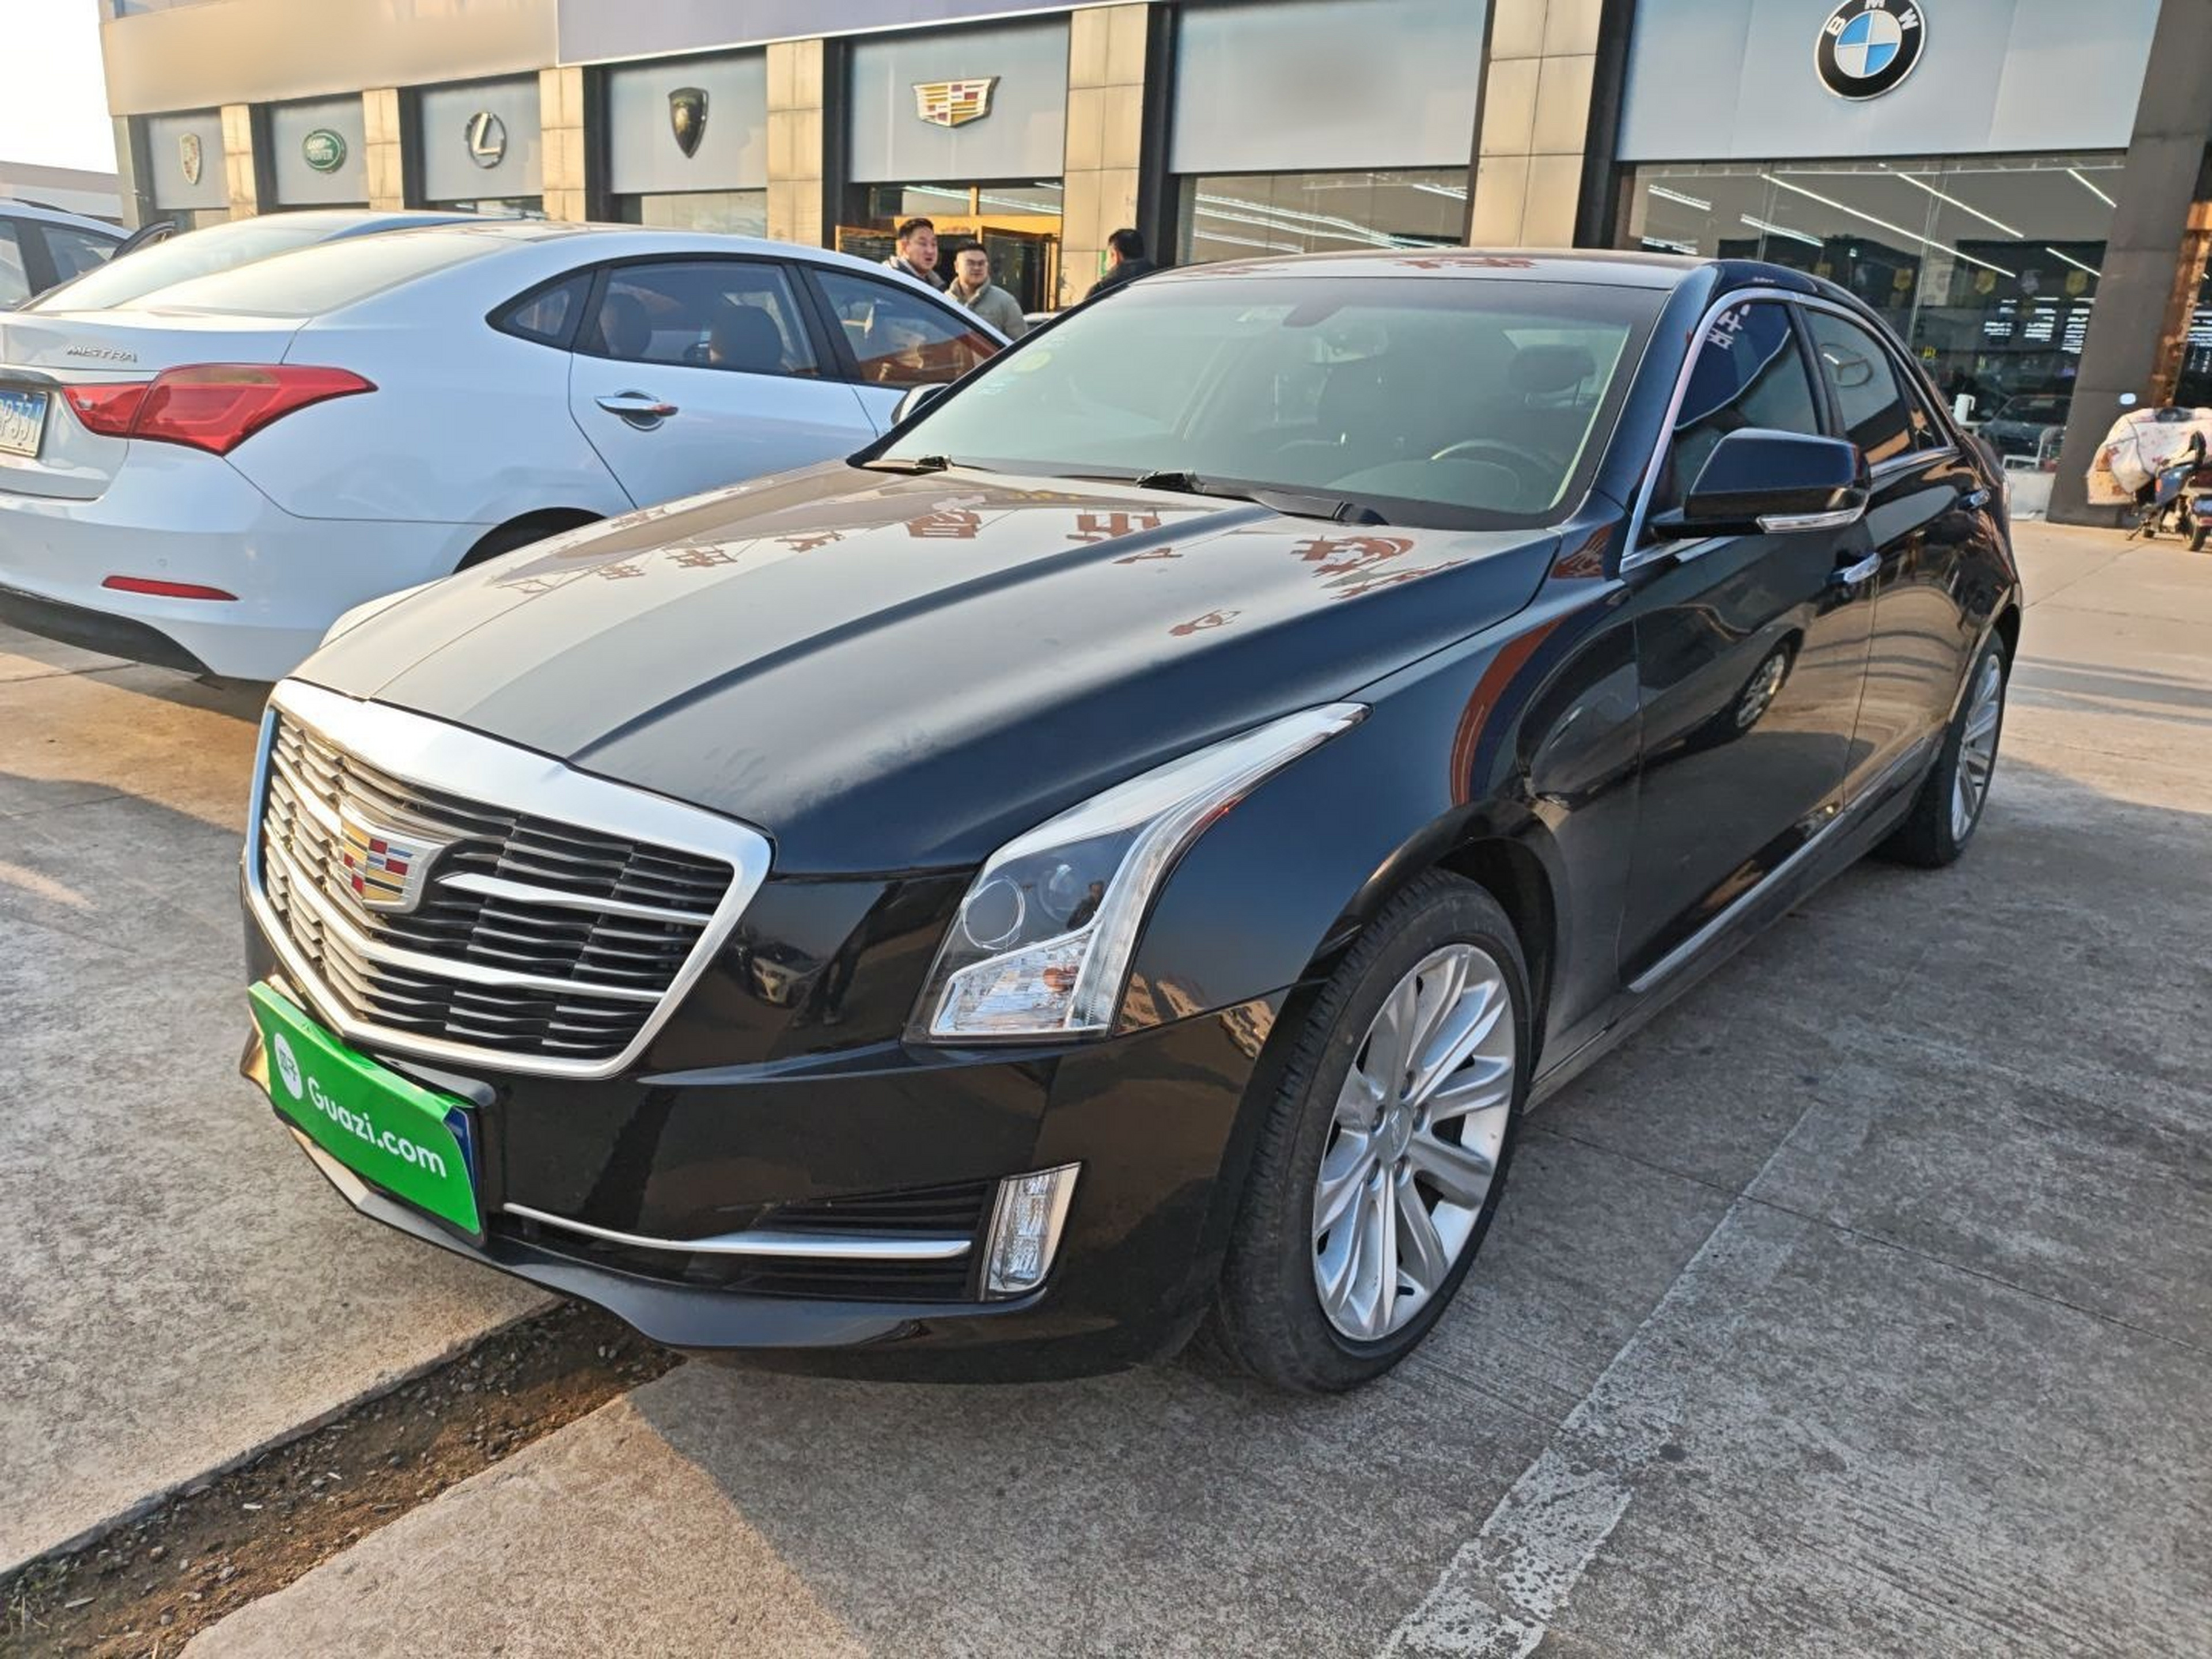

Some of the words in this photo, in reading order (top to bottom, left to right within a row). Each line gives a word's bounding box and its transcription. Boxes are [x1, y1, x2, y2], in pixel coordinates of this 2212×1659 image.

[1826, 0, 1919, 36] BMW
[67, 346, 138, 363] MISTRA
[308, 1077, 448, 1177] Guazi.com
